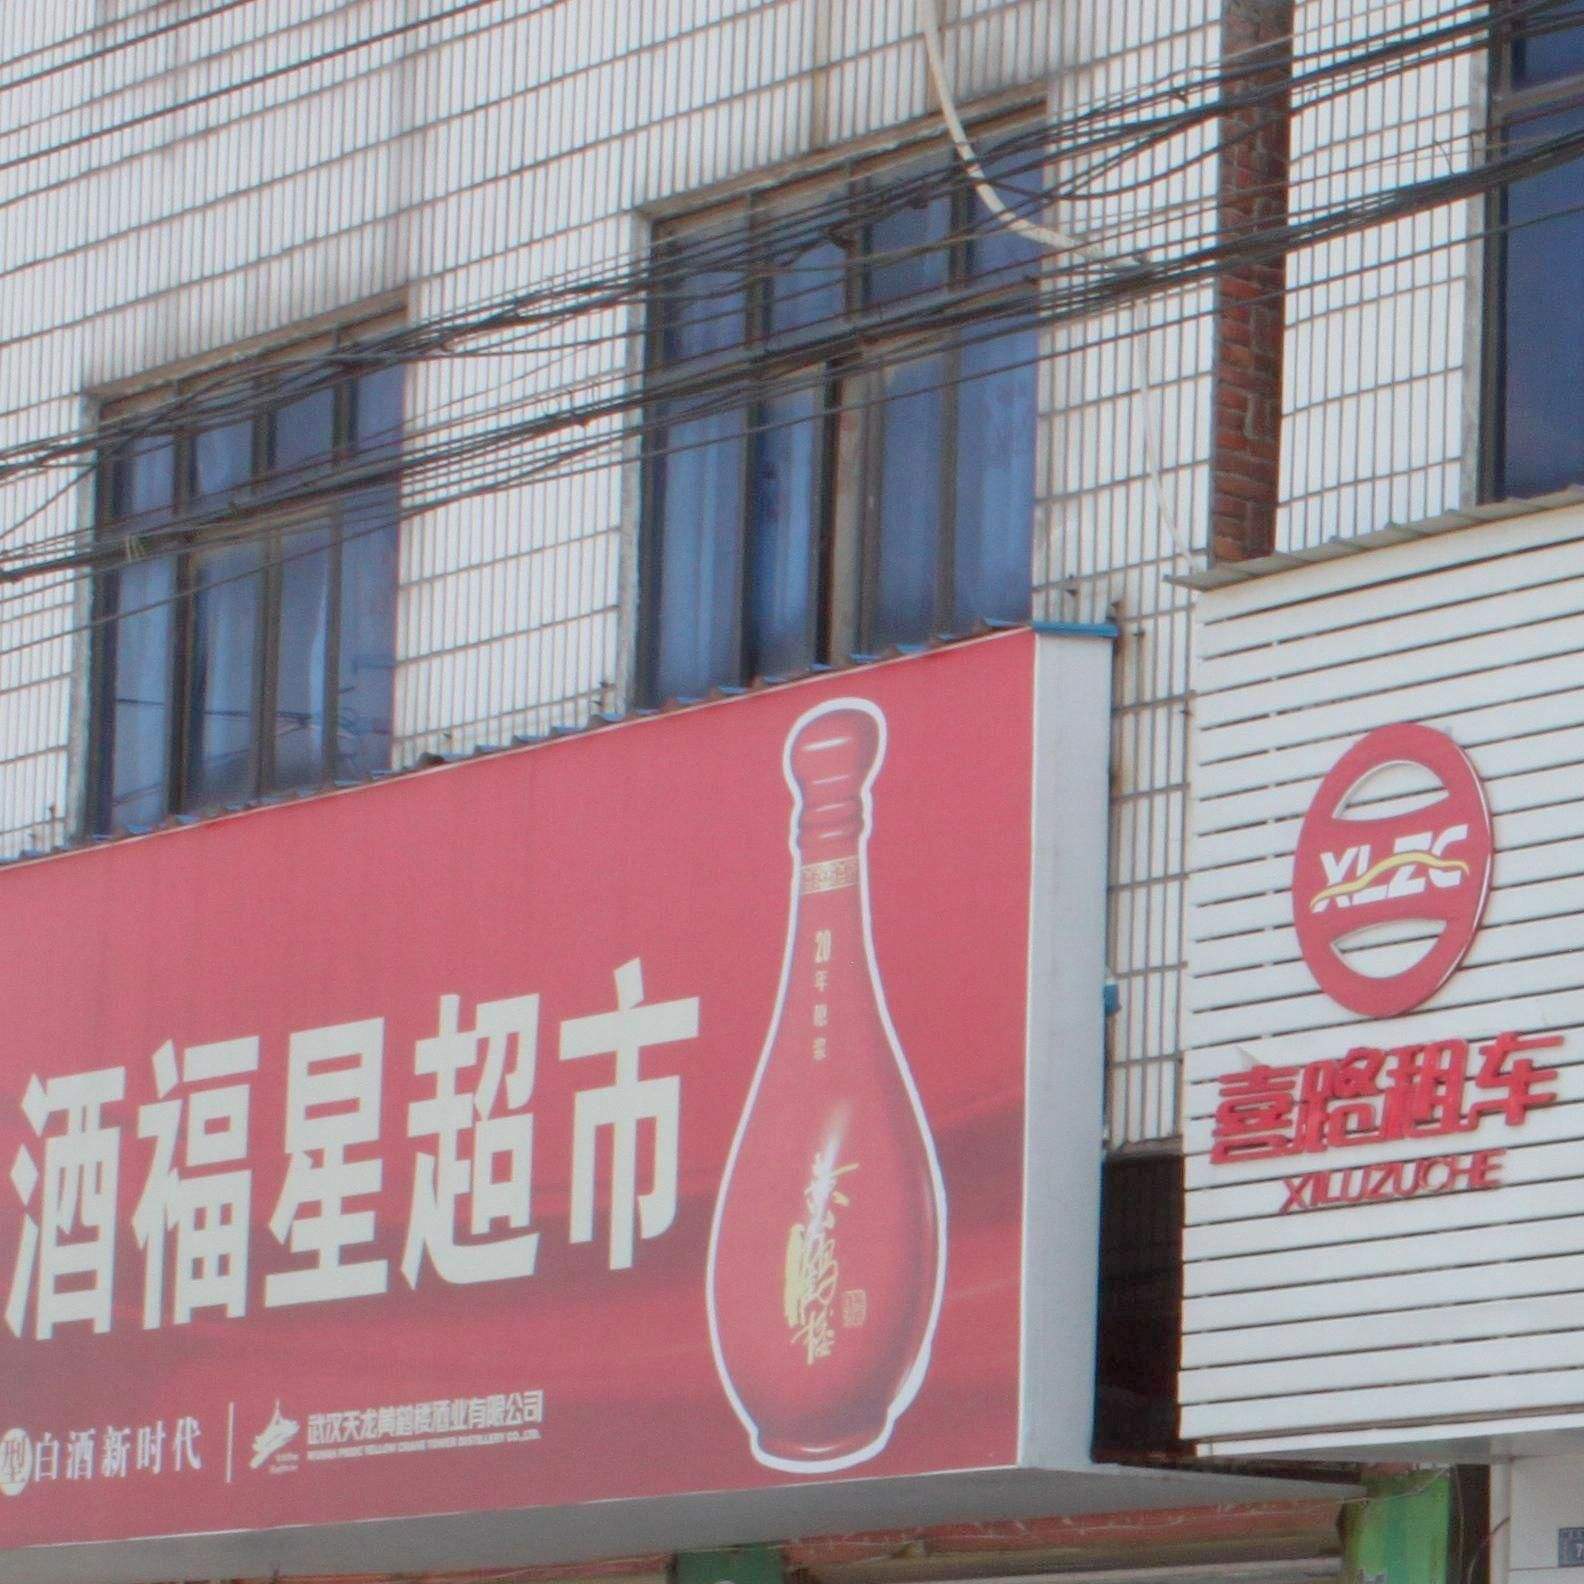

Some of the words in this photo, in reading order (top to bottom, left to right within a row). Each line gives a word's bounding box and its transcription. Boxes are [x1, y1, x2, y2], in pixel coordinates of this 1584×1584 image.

[1310, 824, 1469, 913] XLZC
[4, 957, 701, 1340] 酒福星超市
[1210, 1031, 1566, 1165] 喜路租车
[1276, 1149, 1507, 1215] XILUZUCHE
